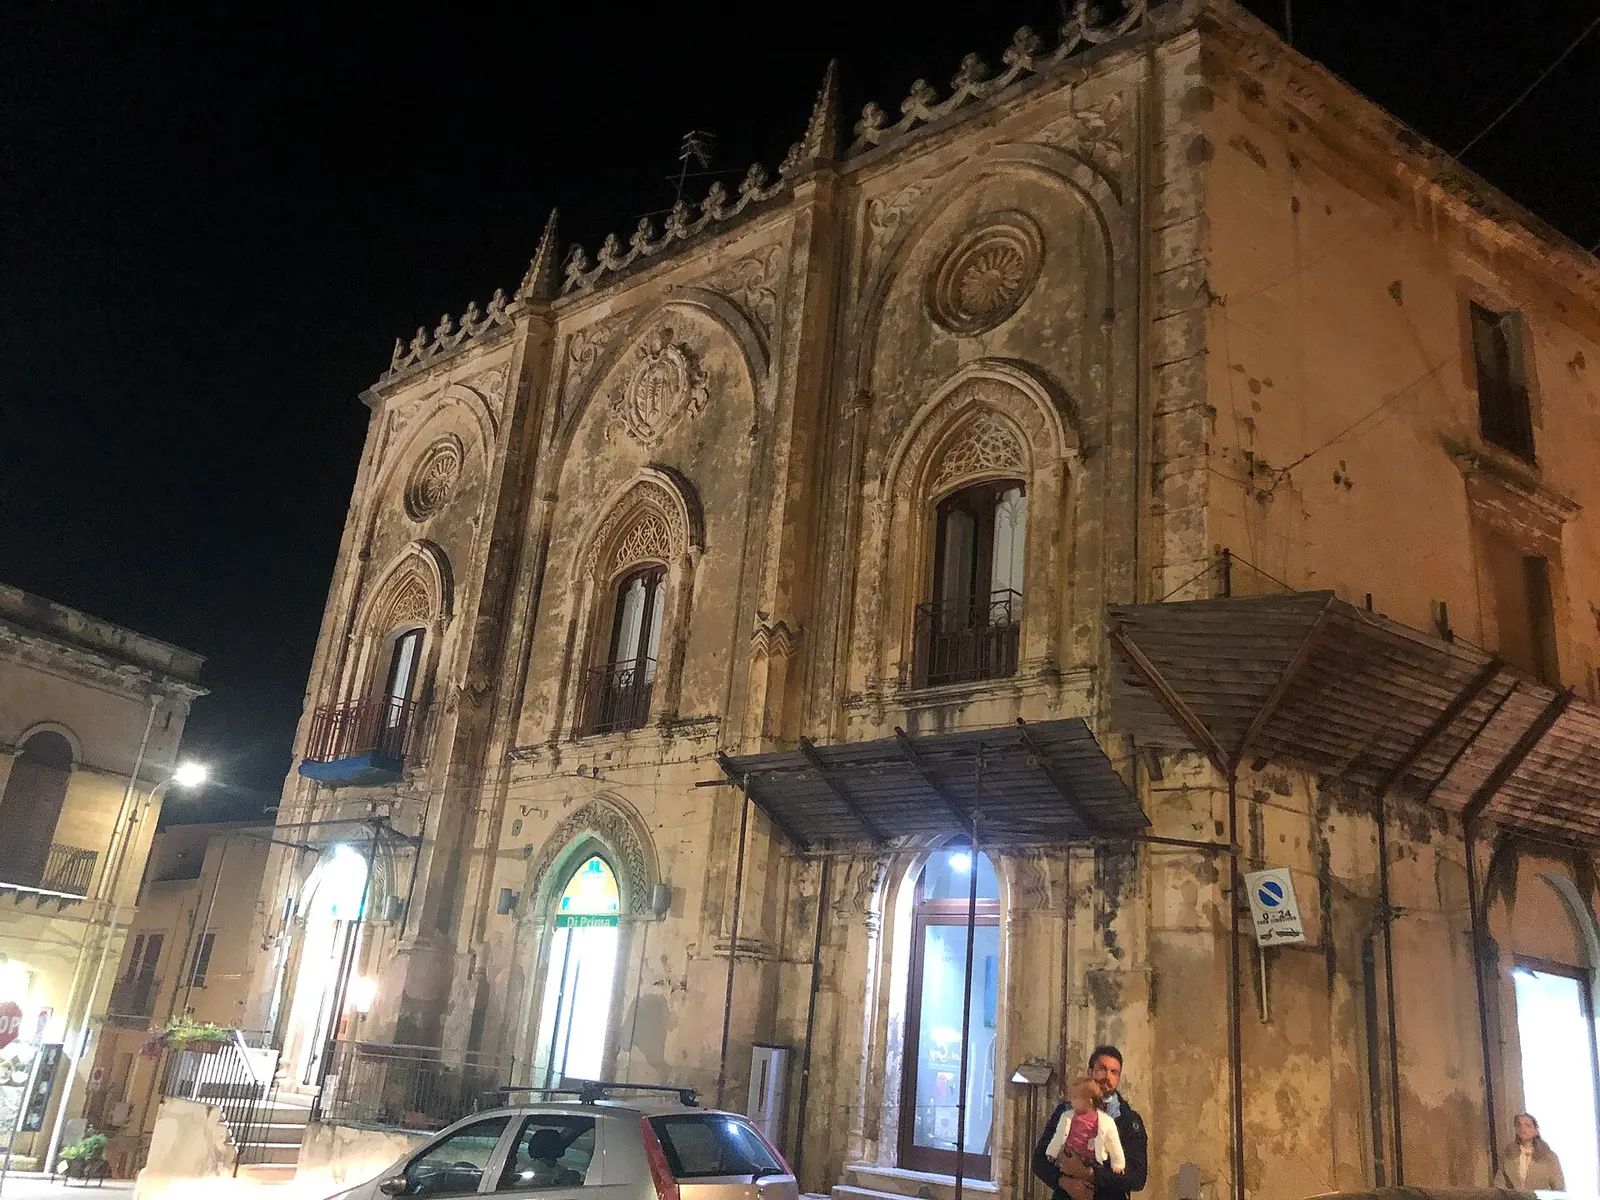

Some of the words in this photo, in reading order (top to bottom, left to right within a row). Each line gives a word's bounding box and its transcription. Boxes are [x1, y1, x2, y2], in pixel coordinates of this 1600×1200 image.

[1278, 910, 1291, 919] 24
[567, 916, 577, 927] Di
[580, 916, 610, 927] Prima
